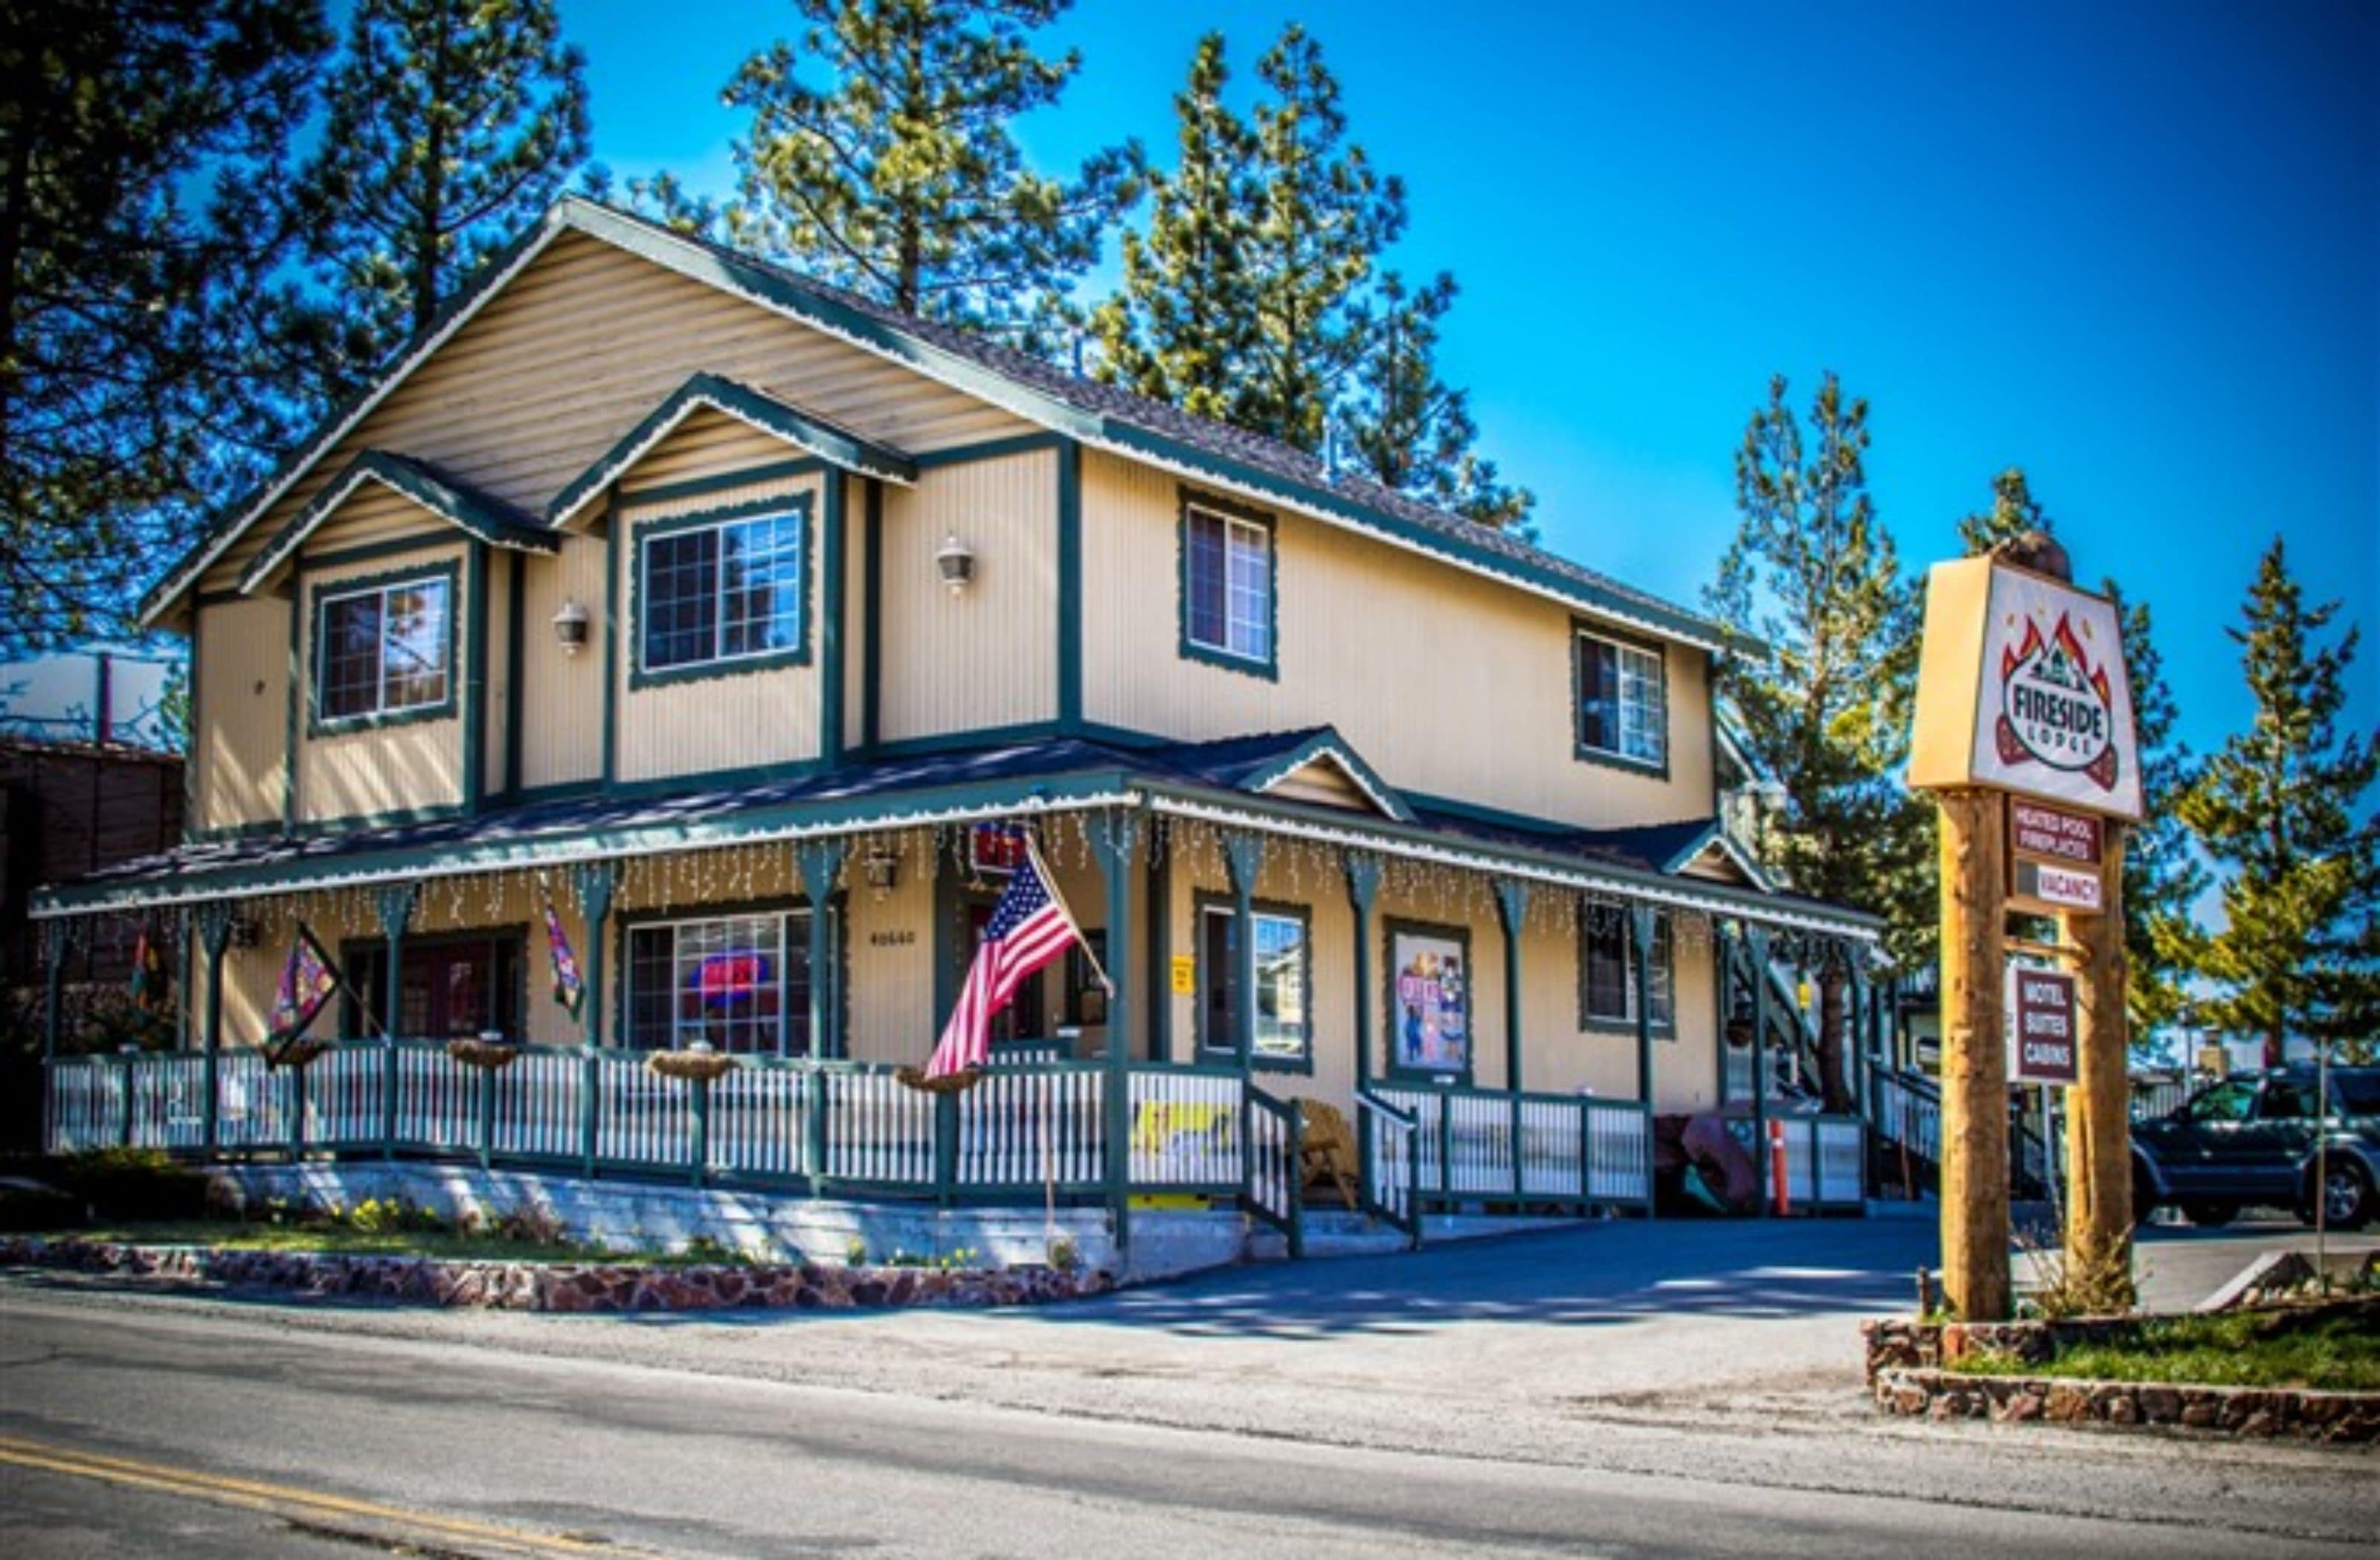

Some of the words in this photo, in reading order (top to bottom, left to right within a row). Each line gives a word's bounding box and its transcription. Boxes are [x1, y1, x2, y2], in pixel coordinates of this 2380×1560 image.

[2013, 684, 2102, 739] FIRESIDE
[2027, 726, 2091, 754] LODGE
[2016, 806, 2061, 831] HEATED
[2062, 816, 2091, 839] POOL
[2041, 870, 2097, 900] VACANCY
[2024, 981, 2067, 1006] MOTEL
[2025, 1012, 2068, 1036] SUITES
[2024, 1042, 2071, 1067] CABINS
